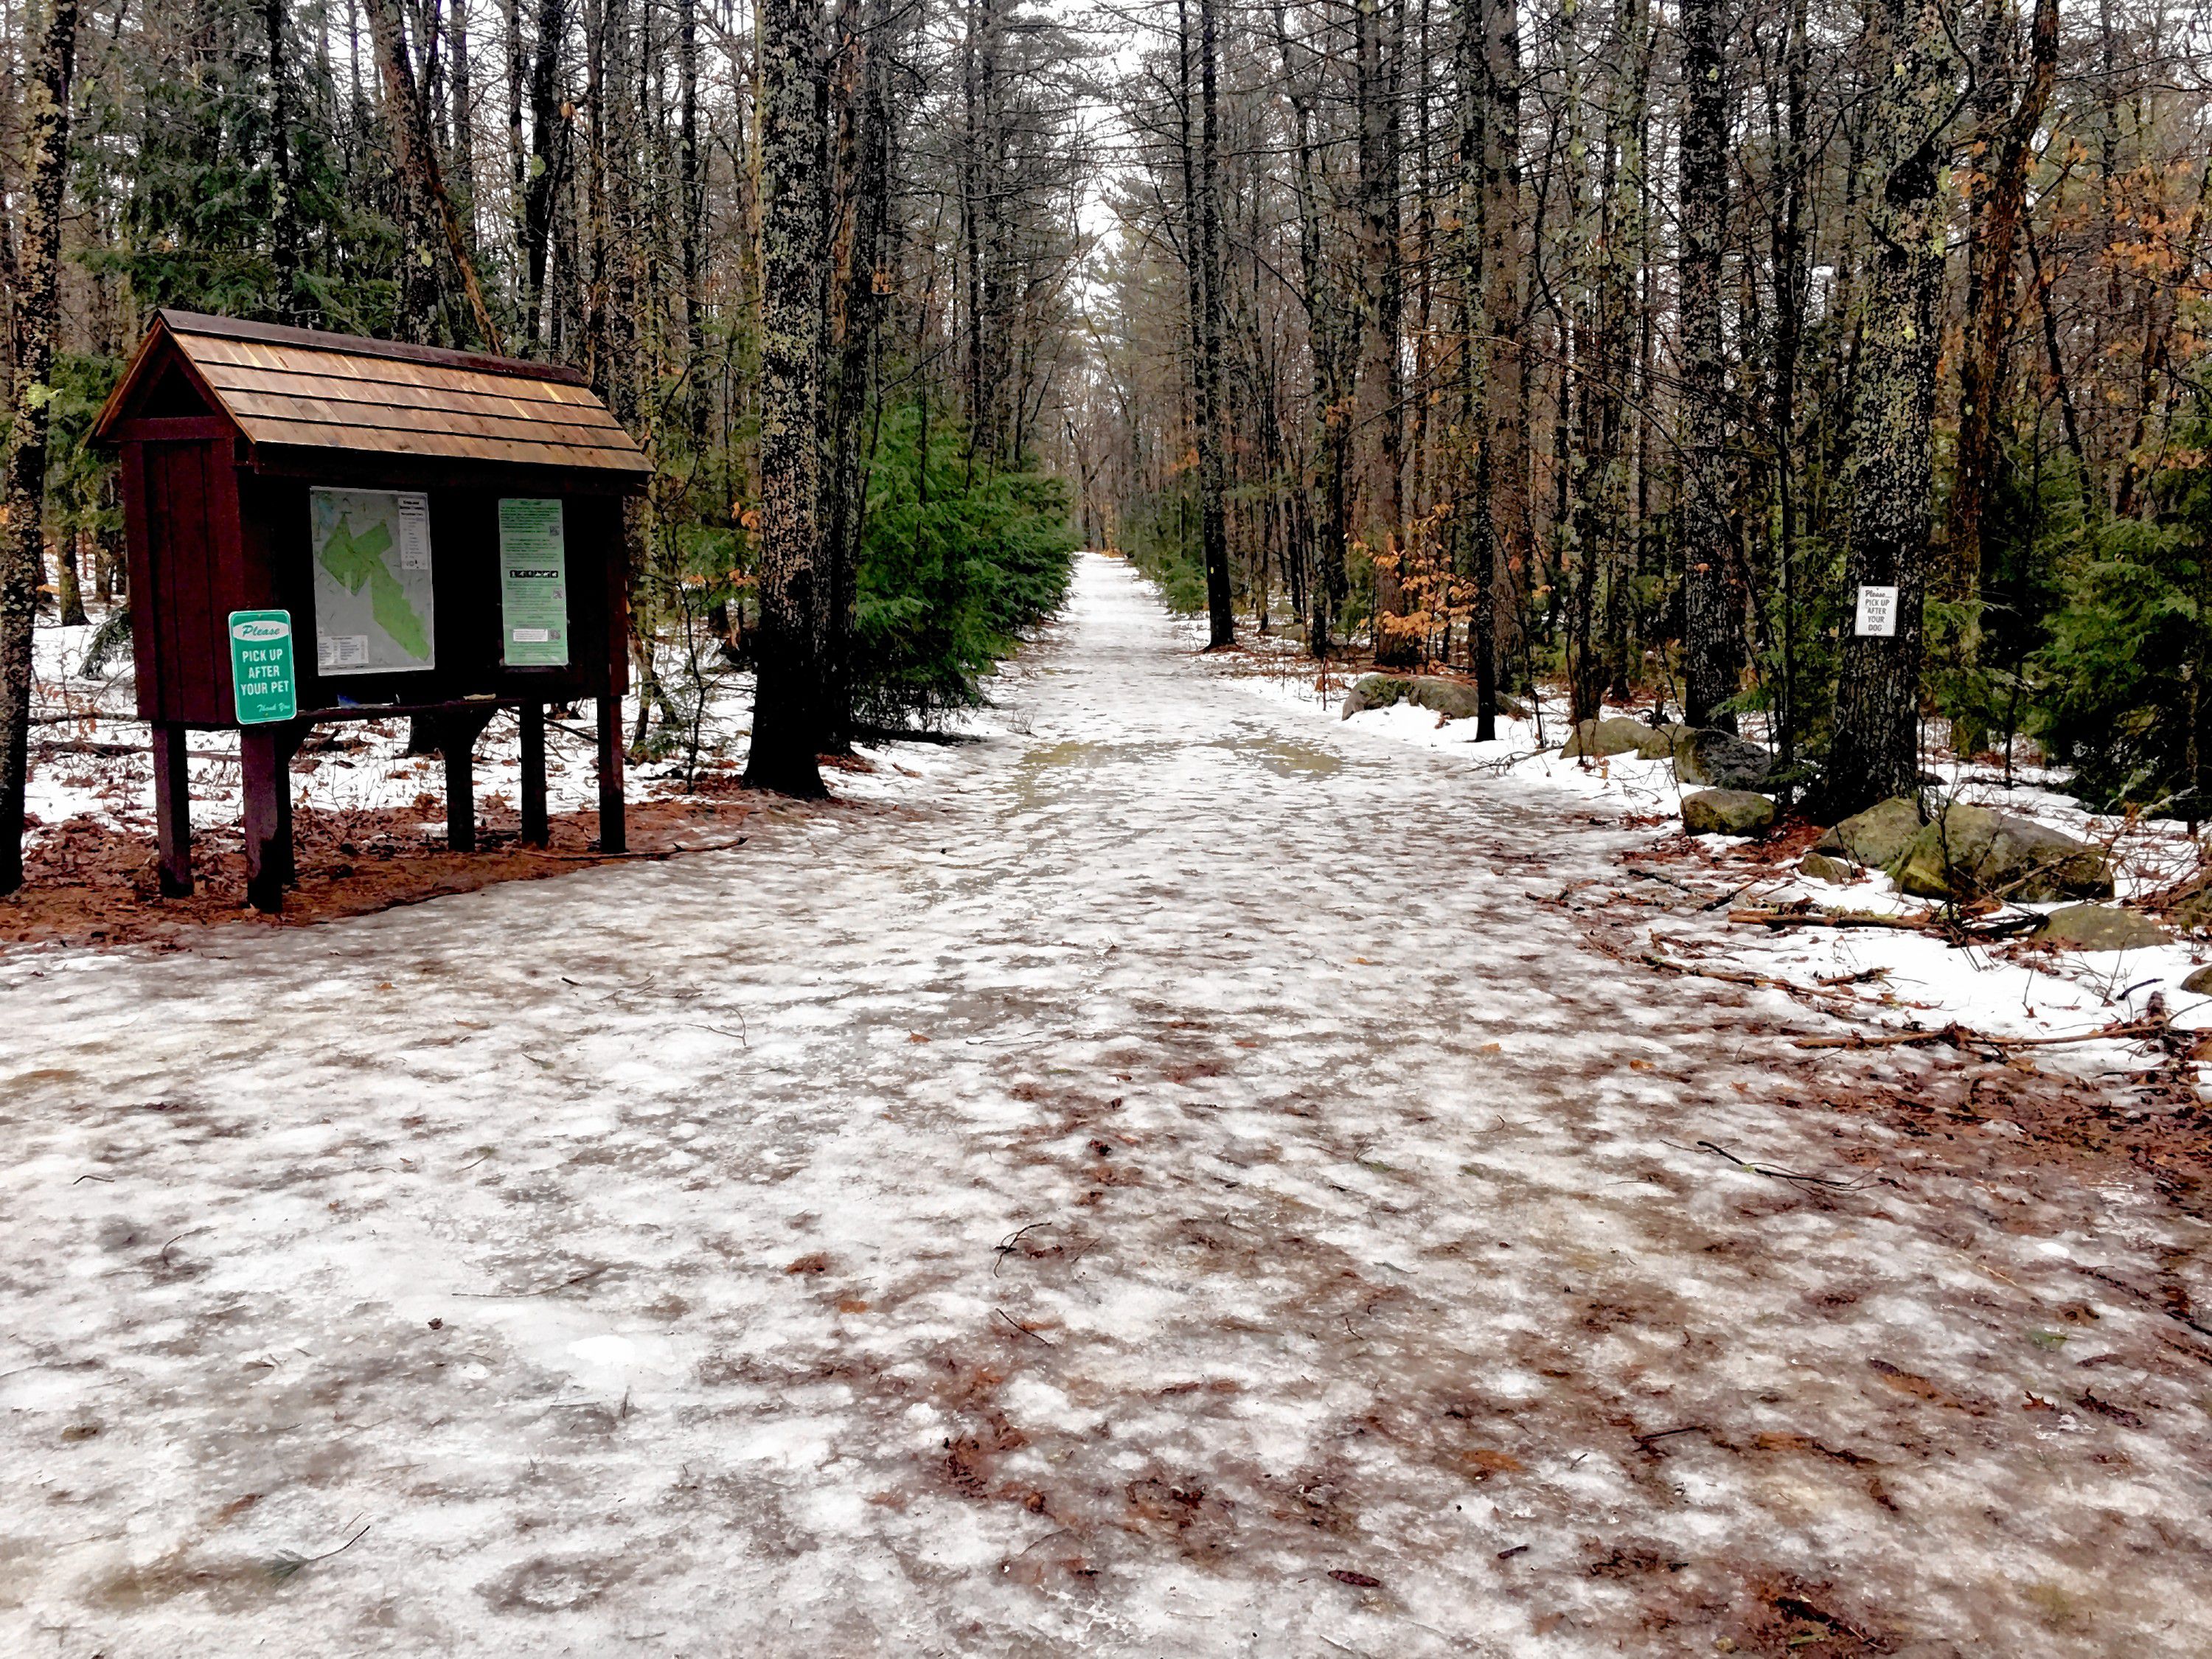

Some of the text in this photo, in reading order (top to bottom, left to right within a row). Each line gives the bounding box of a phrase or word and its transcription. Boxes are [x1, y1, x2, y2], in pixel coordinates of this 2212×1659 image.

[243, 625, 280, 636] Please
[242, 649, 283, 663] PICK UP
[248, 665, 280, 679] AFTER
[240, 681, 289, 696] YOUR PET
[257, 702, 291, 712] Thank You
